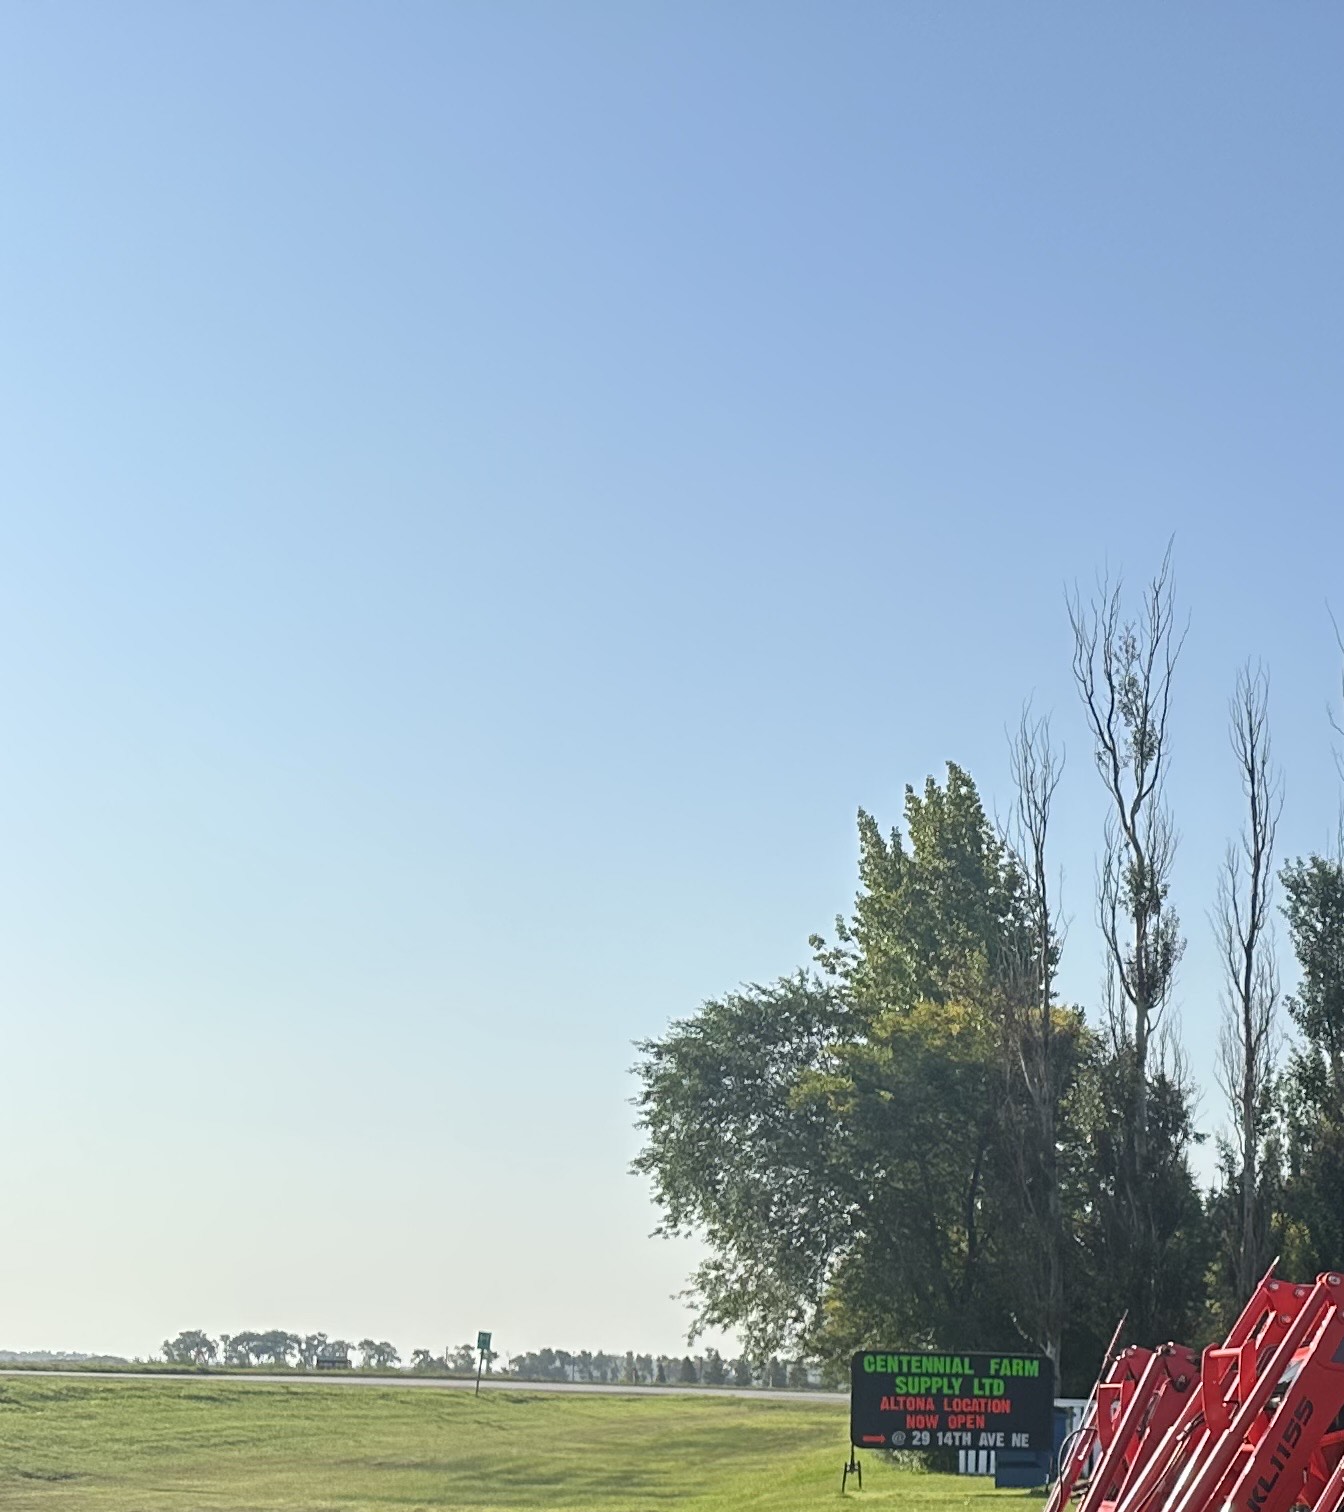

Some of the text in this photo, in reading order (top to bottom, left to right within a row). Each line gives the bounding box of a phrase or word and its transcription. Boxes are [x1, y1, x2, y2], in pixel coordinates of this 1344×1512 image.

[864, 1354, 1040, 1377] CENTENNIAL FARM
[895, 1376, 1005, 1396] SUPPLY LTD
[880, 1396, 1011, 1414] ALTONA LOCATION
[906, 1414, 986, 1429] NOW OPEN
[891, 1431, 1030, 1448] @ 29 14TH AVE NE
